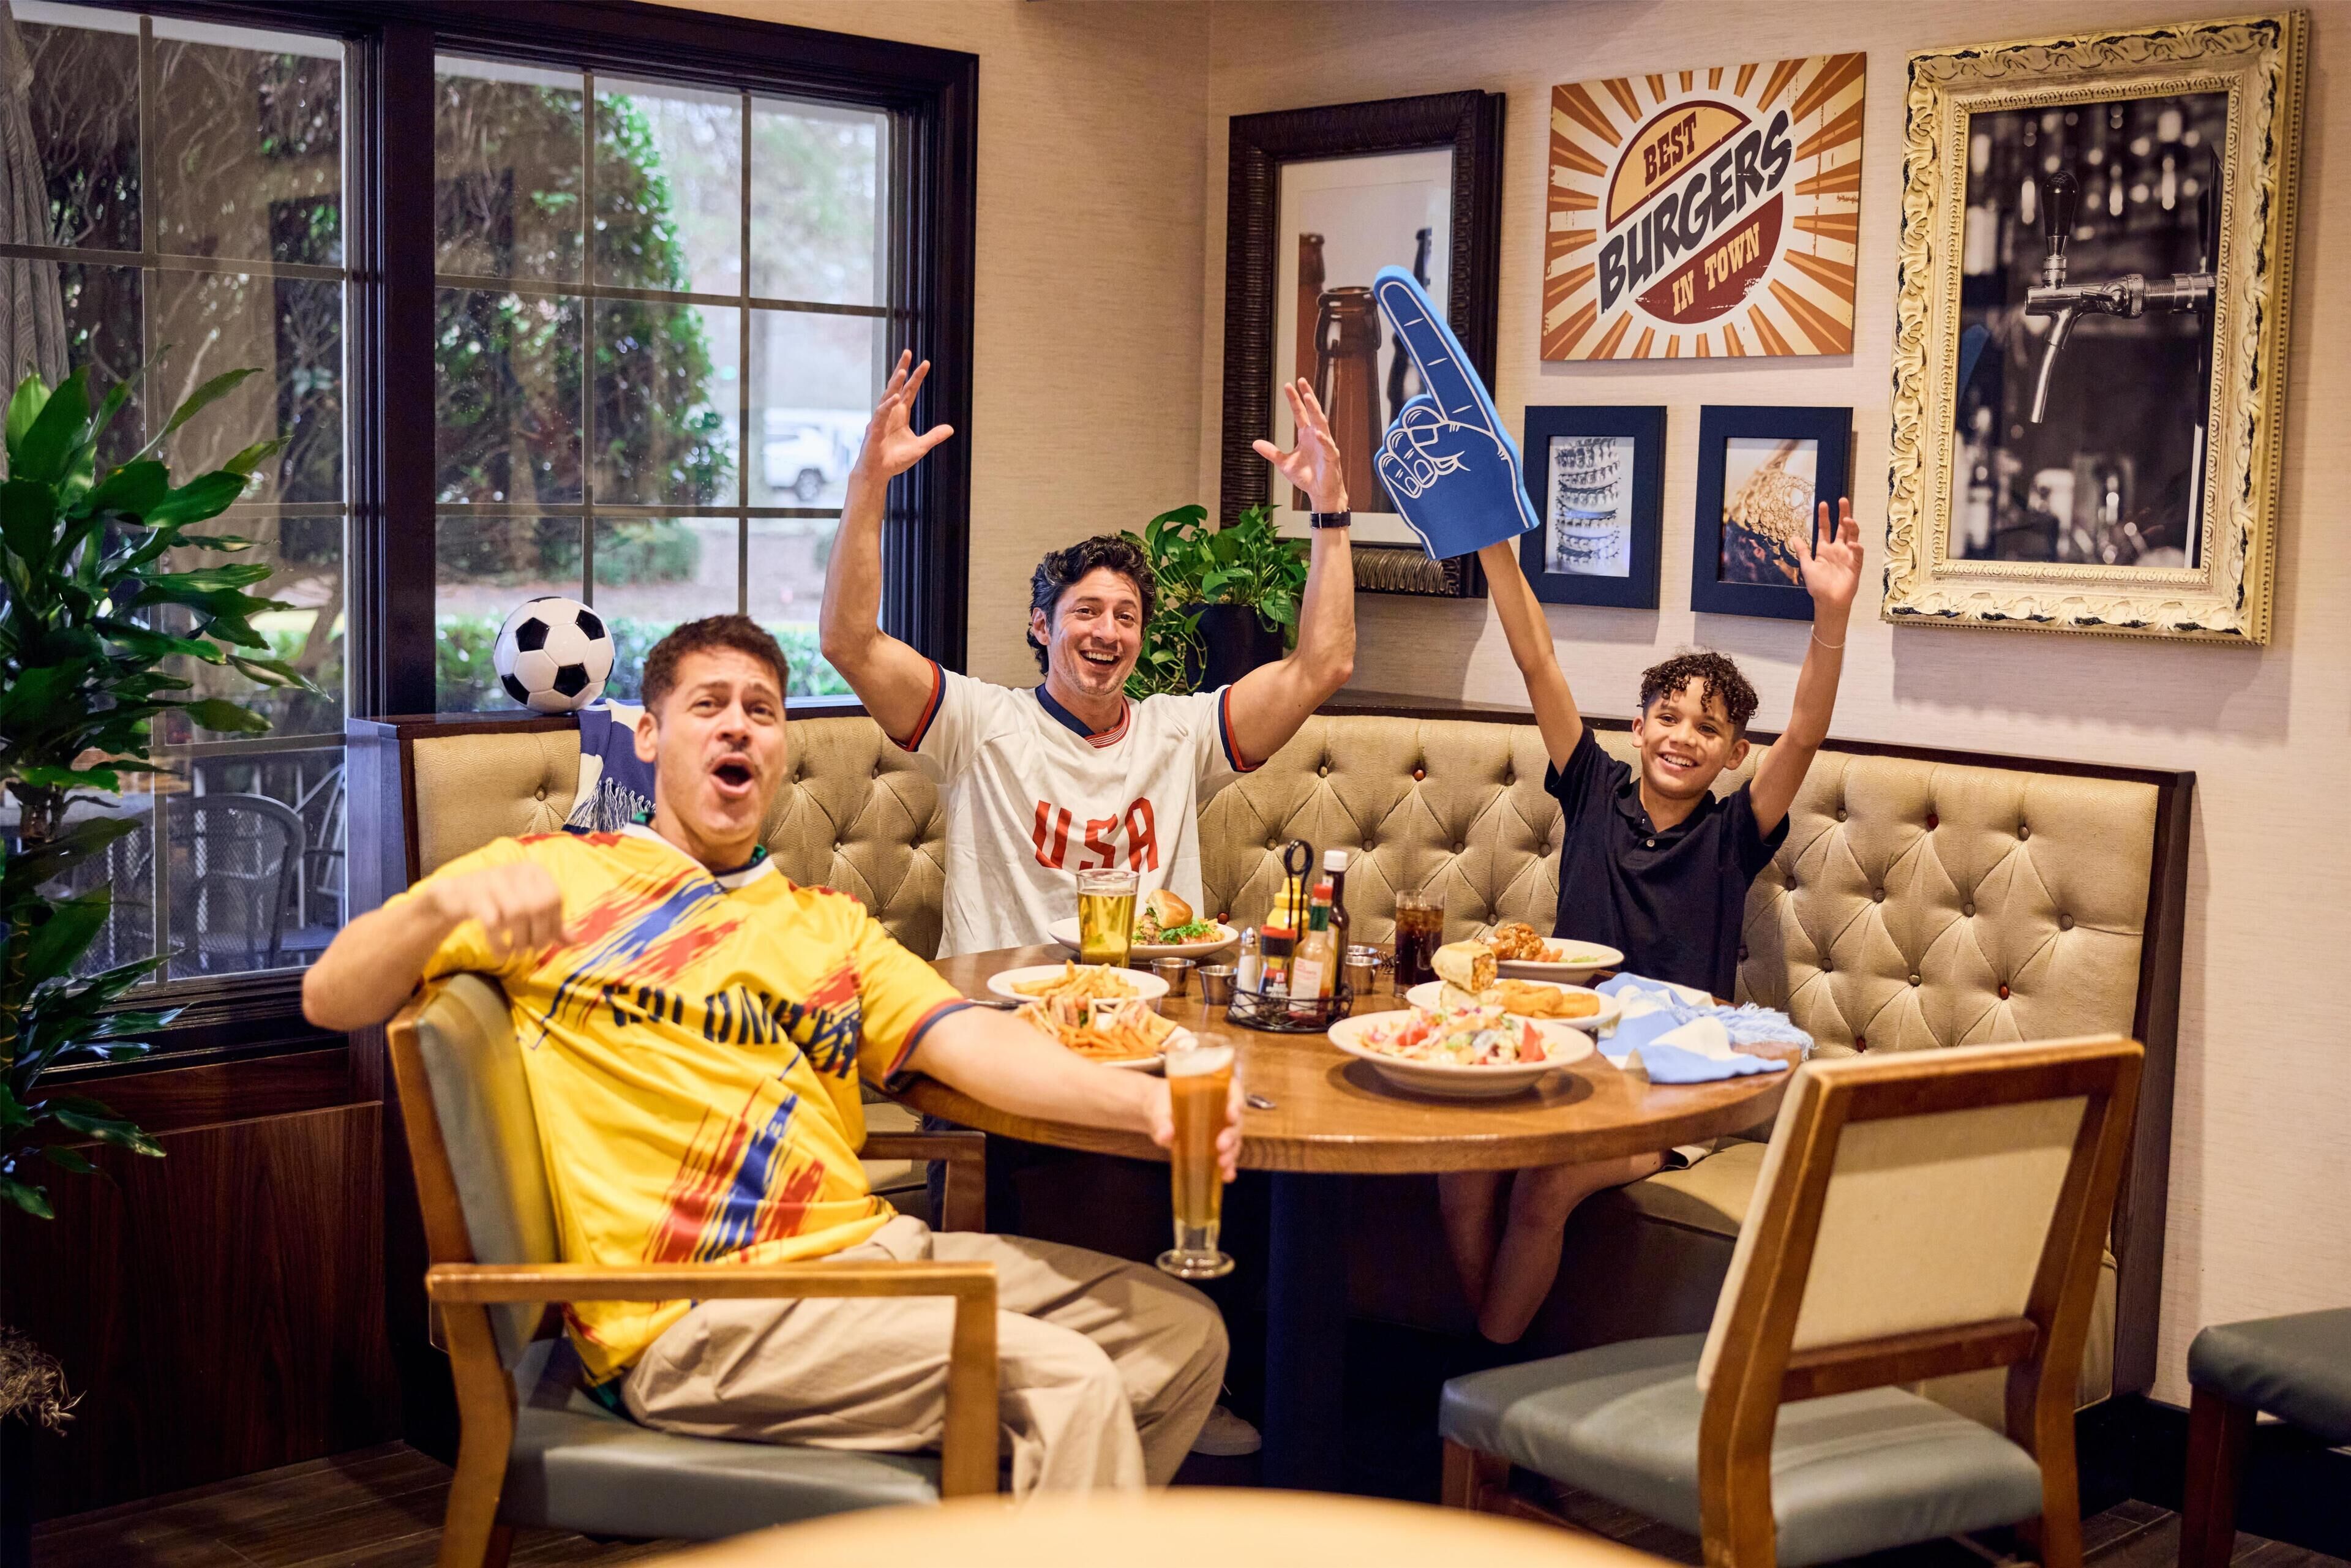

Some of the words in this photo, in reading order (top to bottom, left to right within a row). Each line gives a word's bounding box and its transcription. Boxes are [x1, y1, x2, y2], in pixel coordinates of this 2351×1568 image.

[1643, 111, 1697, 187] BEST
[1599, 110, 1793, 315] BURGERS
[1673, 269, 1695, 317] IN
[1704, 222, 1760, 291] TOWN
[1032, 797, 1160, 874] USA
